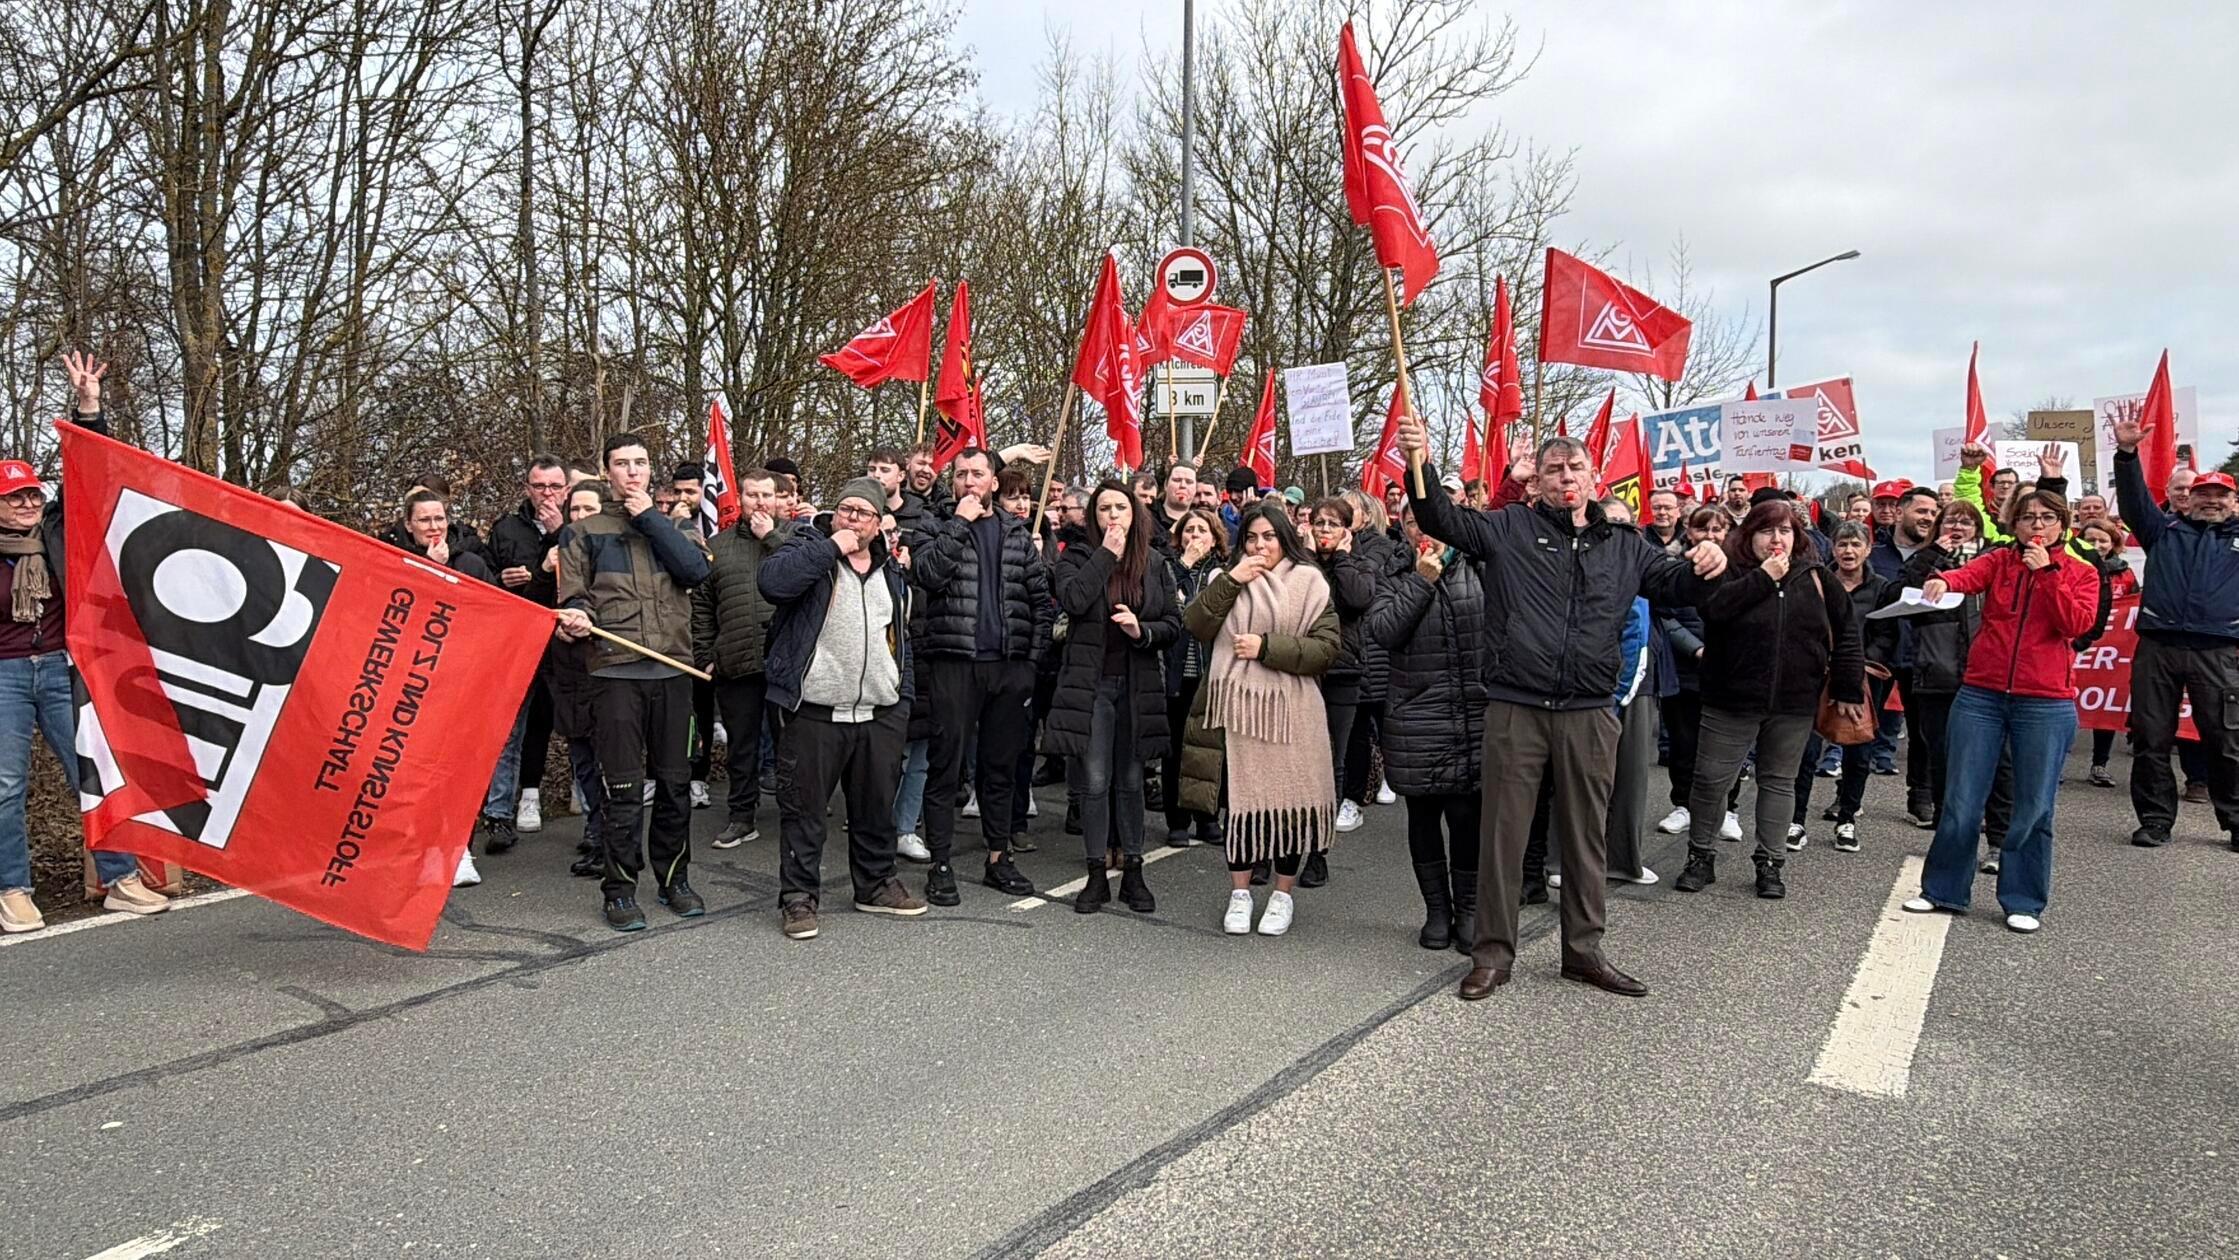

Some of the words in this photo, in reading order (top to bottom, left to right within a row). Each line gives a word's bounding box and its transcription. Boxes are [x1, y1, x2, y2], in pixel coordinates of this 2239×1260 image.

[1184, 390, 1204, 406] km
[2033, 416, 2076, 430] Unsere
[1818, 443, 1862, 462] ken
